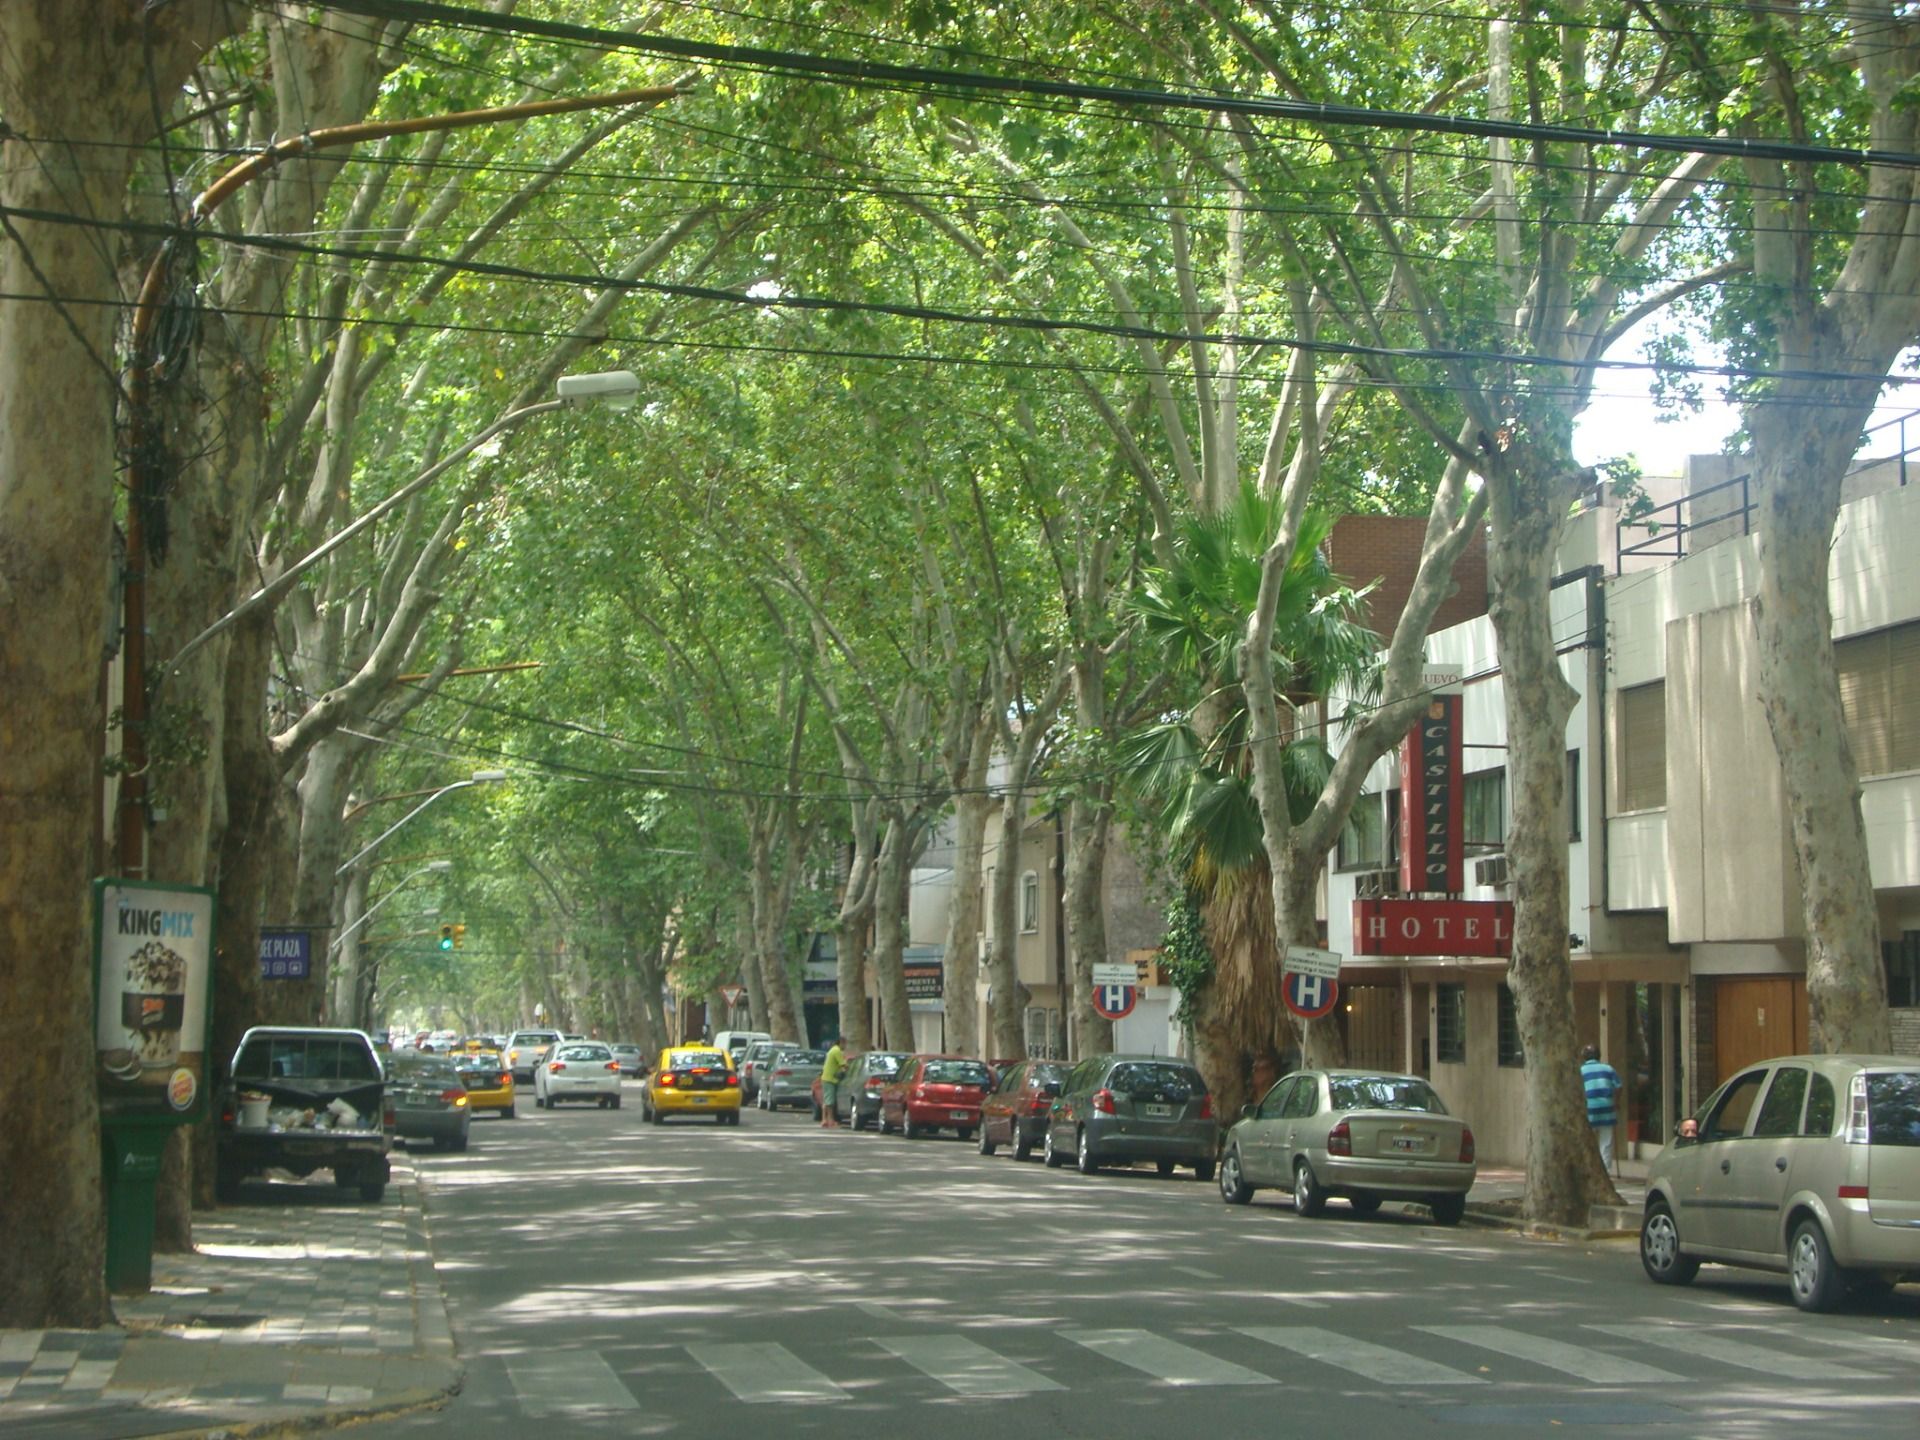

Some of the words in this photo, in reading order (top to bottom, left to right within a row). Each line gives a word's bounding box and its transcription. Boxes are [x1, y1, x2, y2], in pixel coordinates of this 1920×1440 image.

[1424, 674, 1458, 684] UEVO
[1425, 725, 1448, 875] CASTILLO
[118, 908, 195, 938] KINGMIX
[1368, 916, 1510, 940] HOTEL
[273, 939, 301, 958] PLAZA
